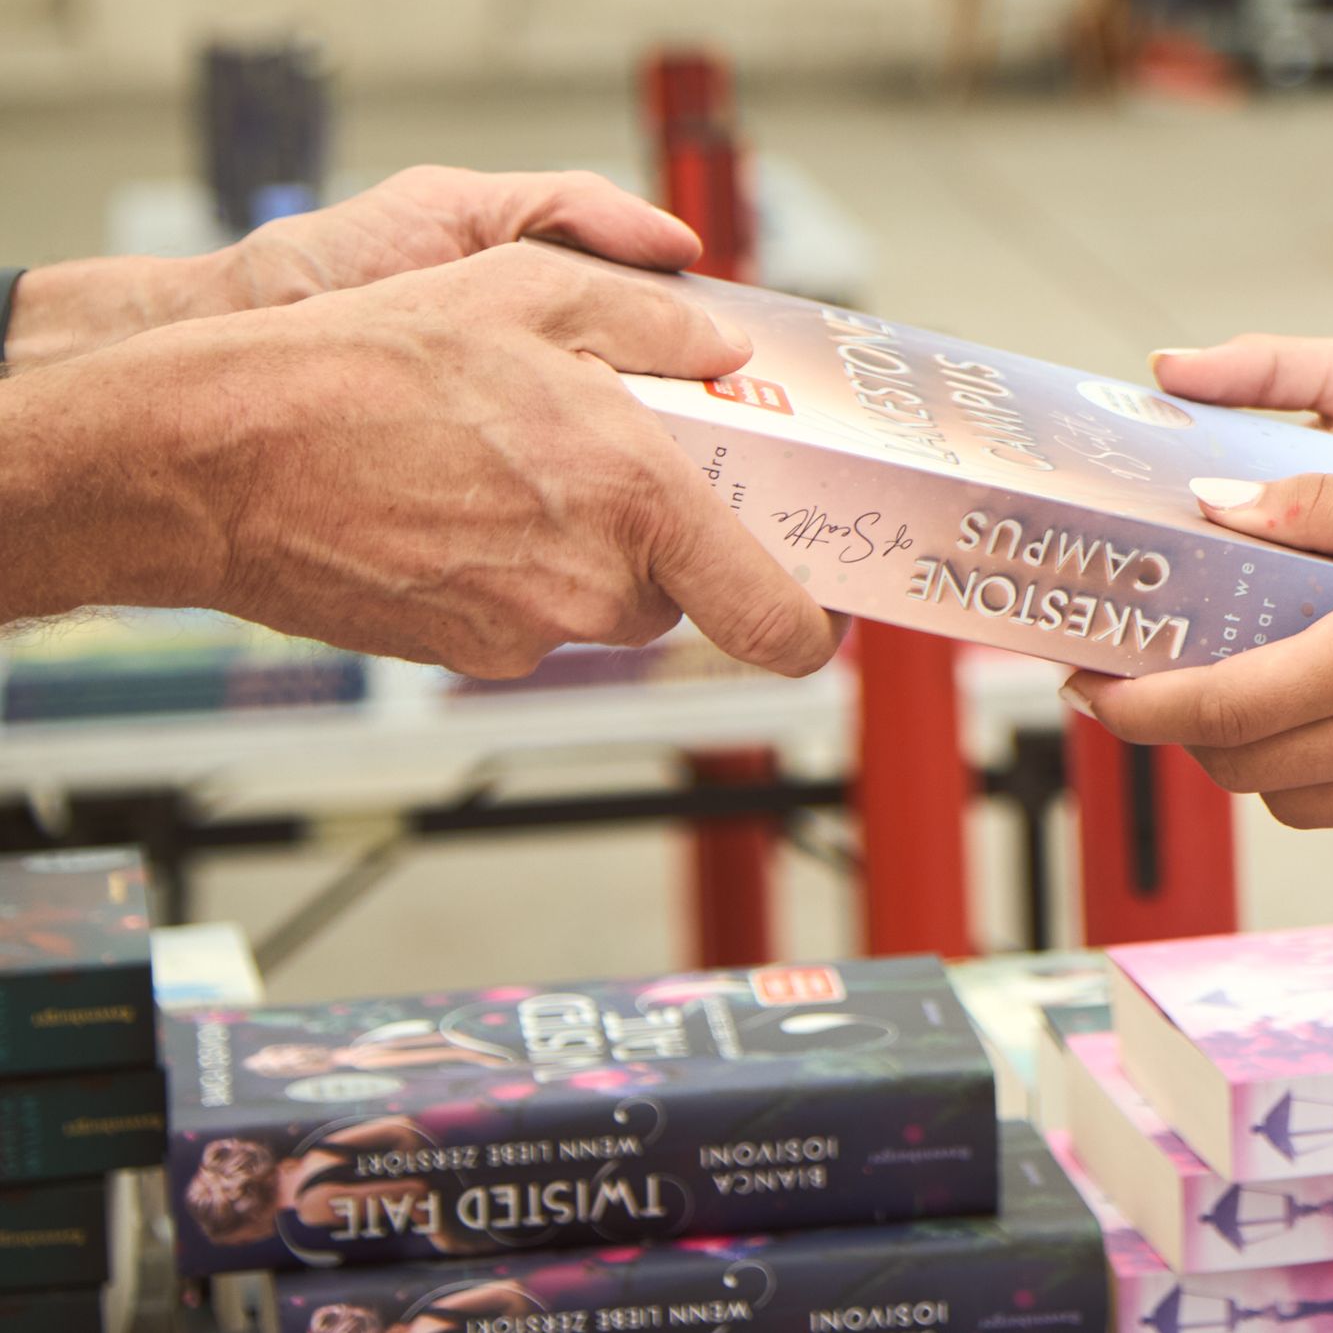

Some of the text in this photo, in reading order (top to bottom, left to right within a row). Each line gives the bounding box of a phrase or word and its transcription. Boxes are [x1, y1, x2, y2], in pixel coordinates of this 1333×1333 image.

[820, 308, 960, 466] LAKESTONE
[934, 353, 1054, 472] CAMPUS
[770, 506, 914, 564] of Seattle
[956, 511, 1171, 592] CAMPUS
[906, 556, 1191, 660] LAKESTONE
[1210, 562, 1255, 658] hat we
[1243, 597, 1276, 650] ear
[354, 1134, 643, 1177] WENN LIEBE ZERSTÖRT
[700, 1136, 839, 1169] IOSIVONI
[329, 1173, 669, 1243] TWISTED FATE
[712, 1166, 828, 1196] BIANCA
[595, 1303, 663, 1329] LIEBE
[669, 1299, 754, 1326] WENN
[809, 1299, 949, 1333] IOSIVONI
